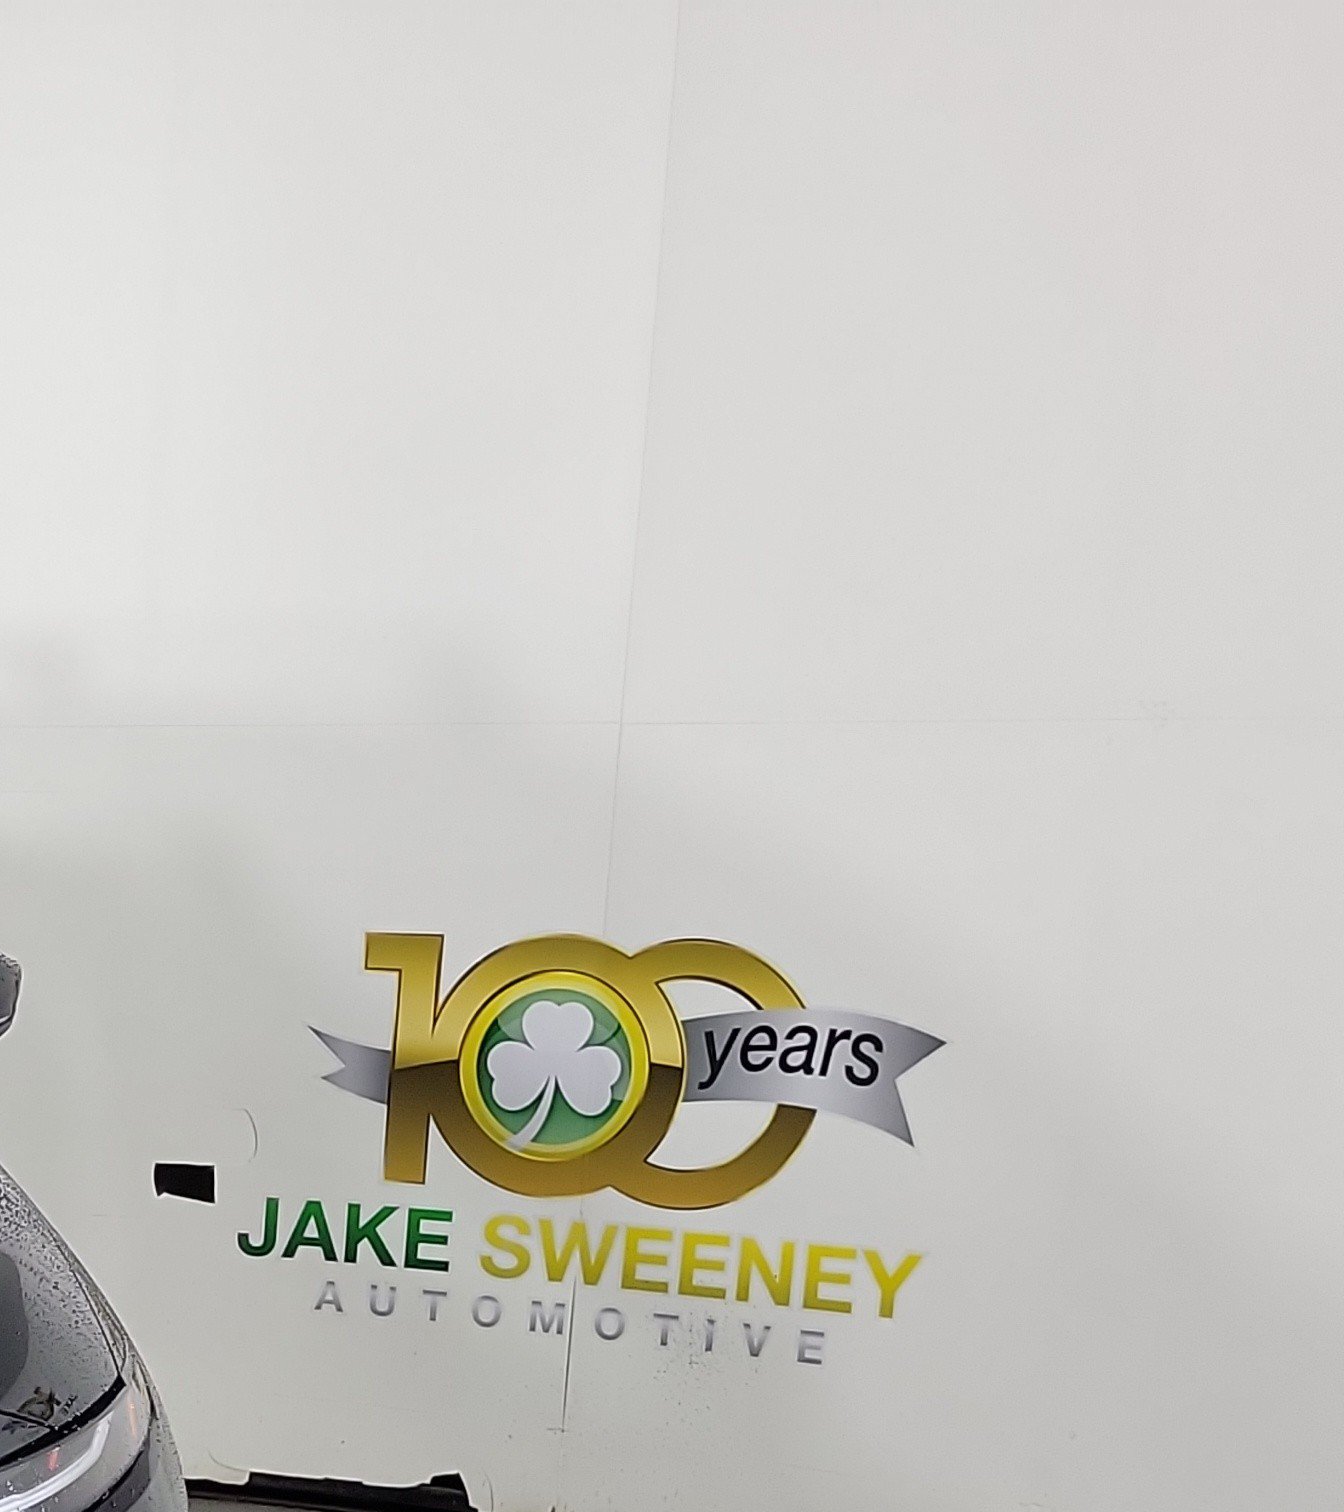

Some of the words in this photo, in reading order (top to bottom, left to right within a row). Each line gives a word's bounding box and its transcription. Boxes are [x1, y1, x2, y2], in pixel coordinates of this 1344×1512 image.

[364, 932, 817, 1210] 100
[697, 1022, 885, 1092] years
[236, 1197, 455, 1273] JAKE
[478, 1213, 923, 1320] SWEENEY
[314, 1281, 826, 1366] AUTOMOTIVE
